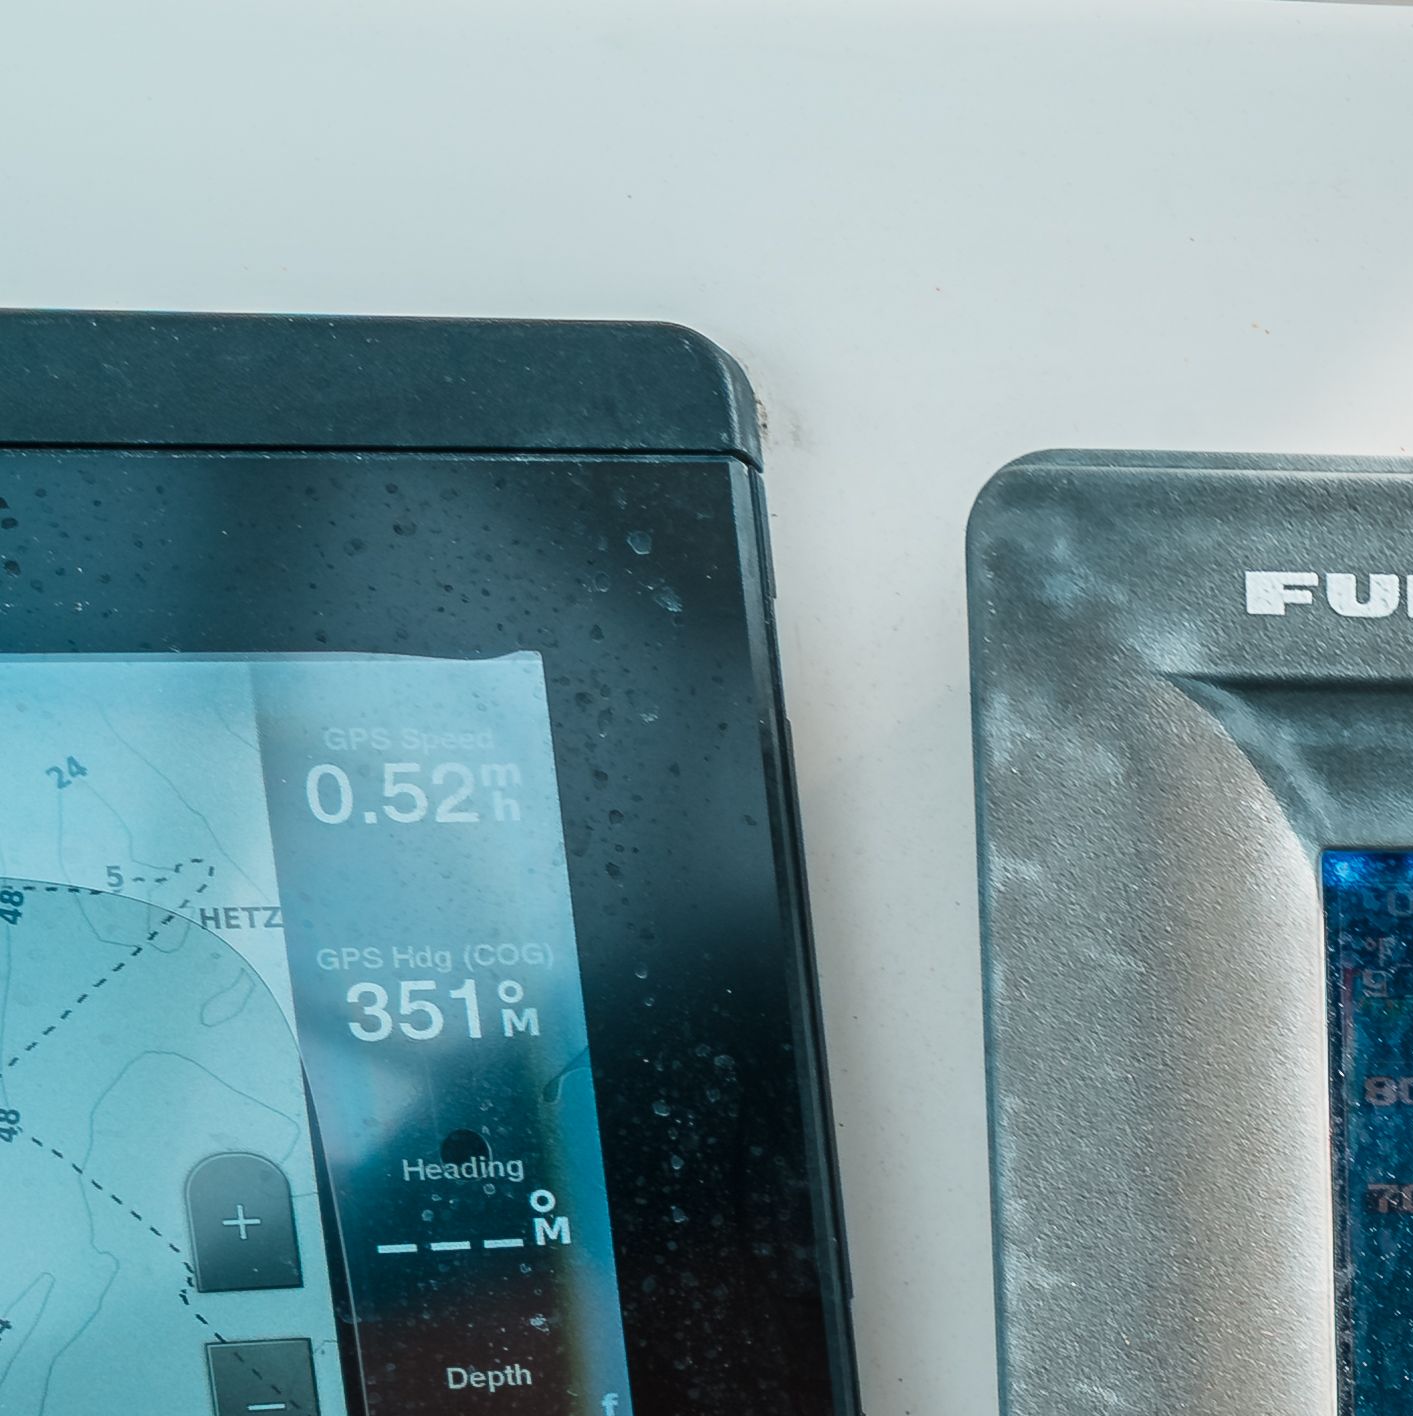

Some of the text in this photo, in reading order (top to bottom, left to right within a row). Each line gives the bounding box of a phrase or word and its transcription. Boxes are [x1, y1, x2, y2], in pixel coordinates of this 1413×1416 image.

[324, 728, 494, 755] GPS Speed
[46, 756, 87, 789] 24
[306, 762, 480, 825] 0.52
[316, 943, 554, 974] GPS Hdg (COG)
[346, 978, 482, 1041] 351
[402, 1156, 525, 1182] Heading
[447, 1364, 533, 1393] Depth
